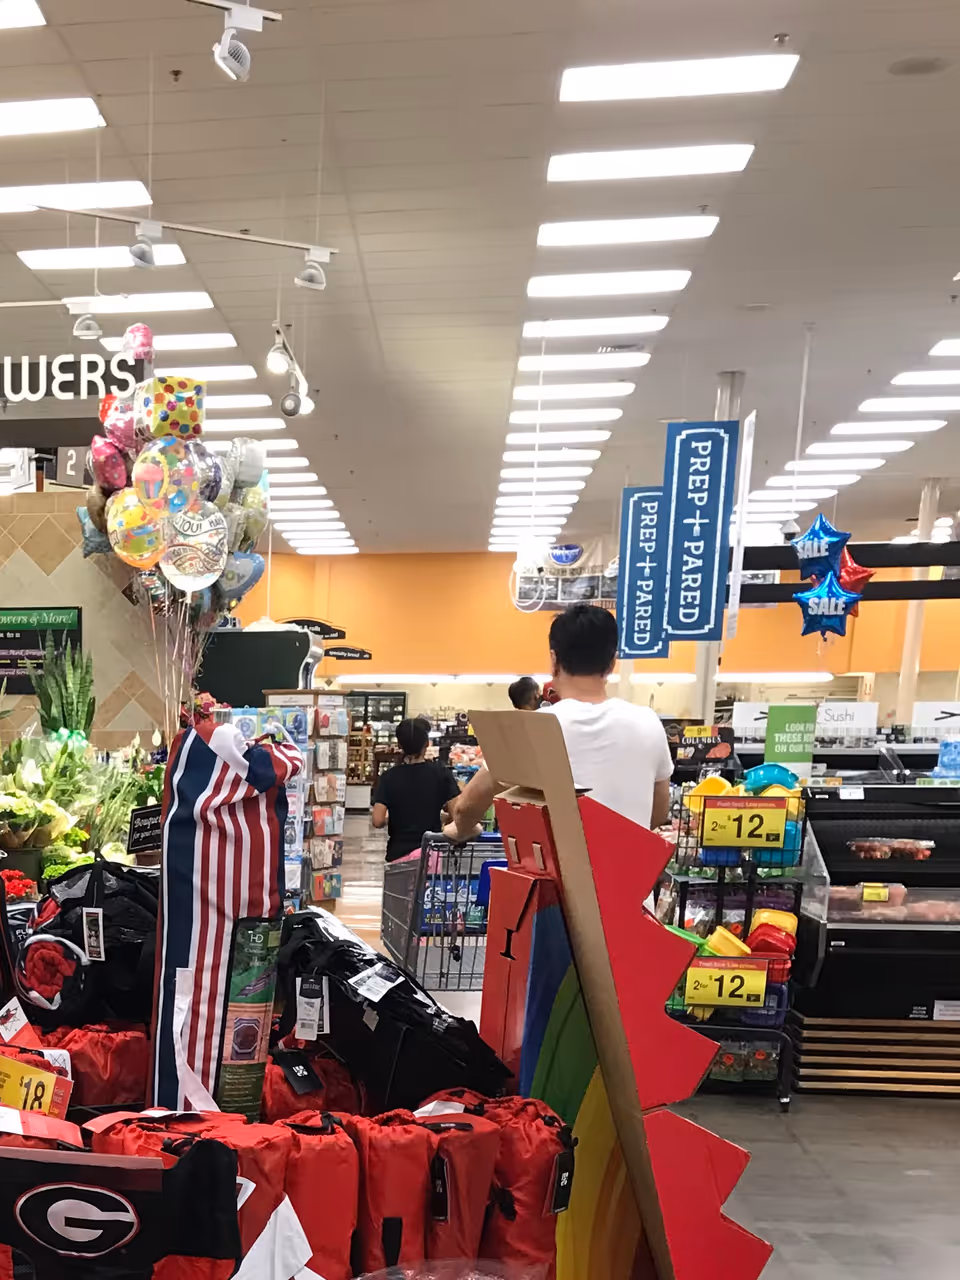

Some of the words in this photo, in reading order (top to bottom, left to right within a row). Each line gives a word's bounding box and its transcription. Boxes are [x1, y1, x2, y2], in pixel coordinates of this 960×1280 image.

[66, 449, 77, 476] 2
[798, 541, 829, 559] SALE
[808, 598, 845, 615] SALE
[40, 611, 73, 624] More!
[824, 708, 855, 722] Sushi
